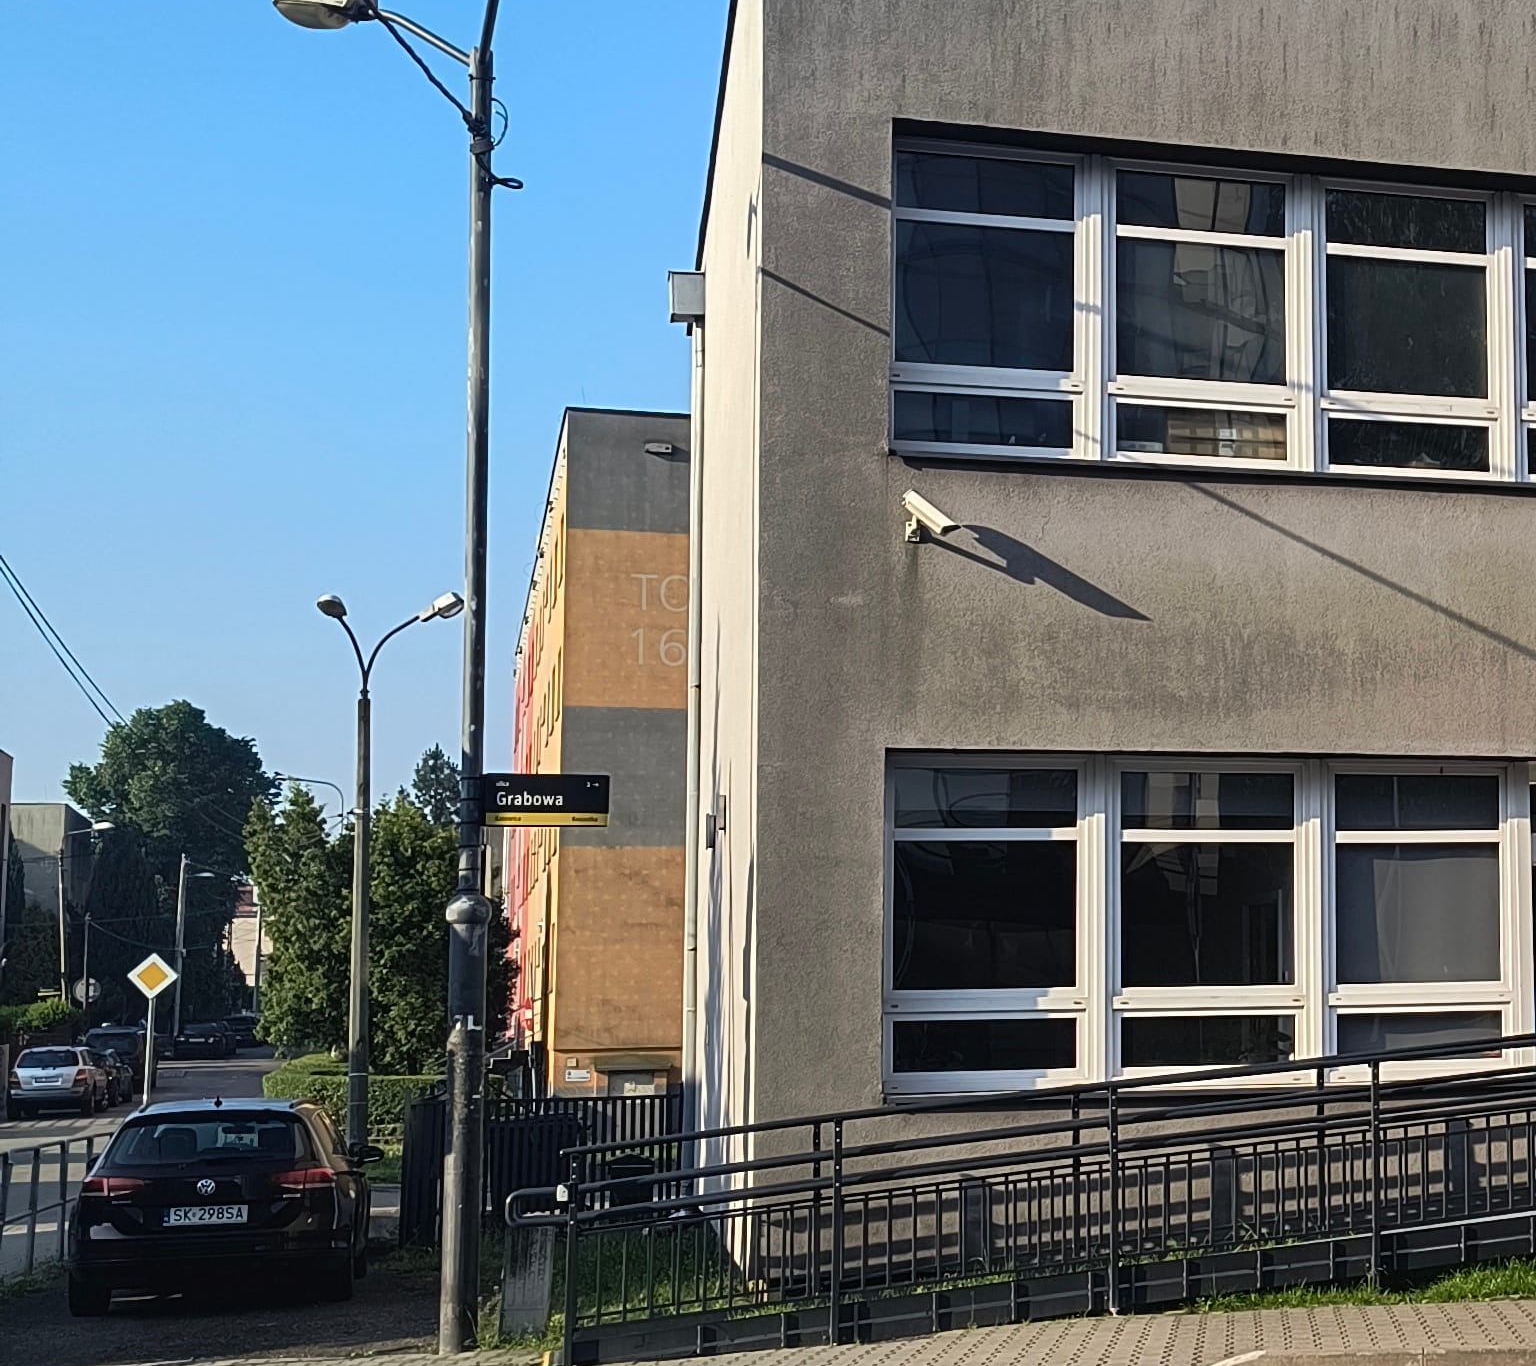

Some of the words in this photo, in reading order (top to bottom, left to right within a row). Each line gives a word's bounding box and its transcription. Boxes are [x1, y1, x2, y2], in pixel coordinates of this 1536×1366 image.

[496, 790, 564, 806] Grabowa
[173, 1208, 192, 1222] SK
[198, 1206, 244, 1221] 298SA
